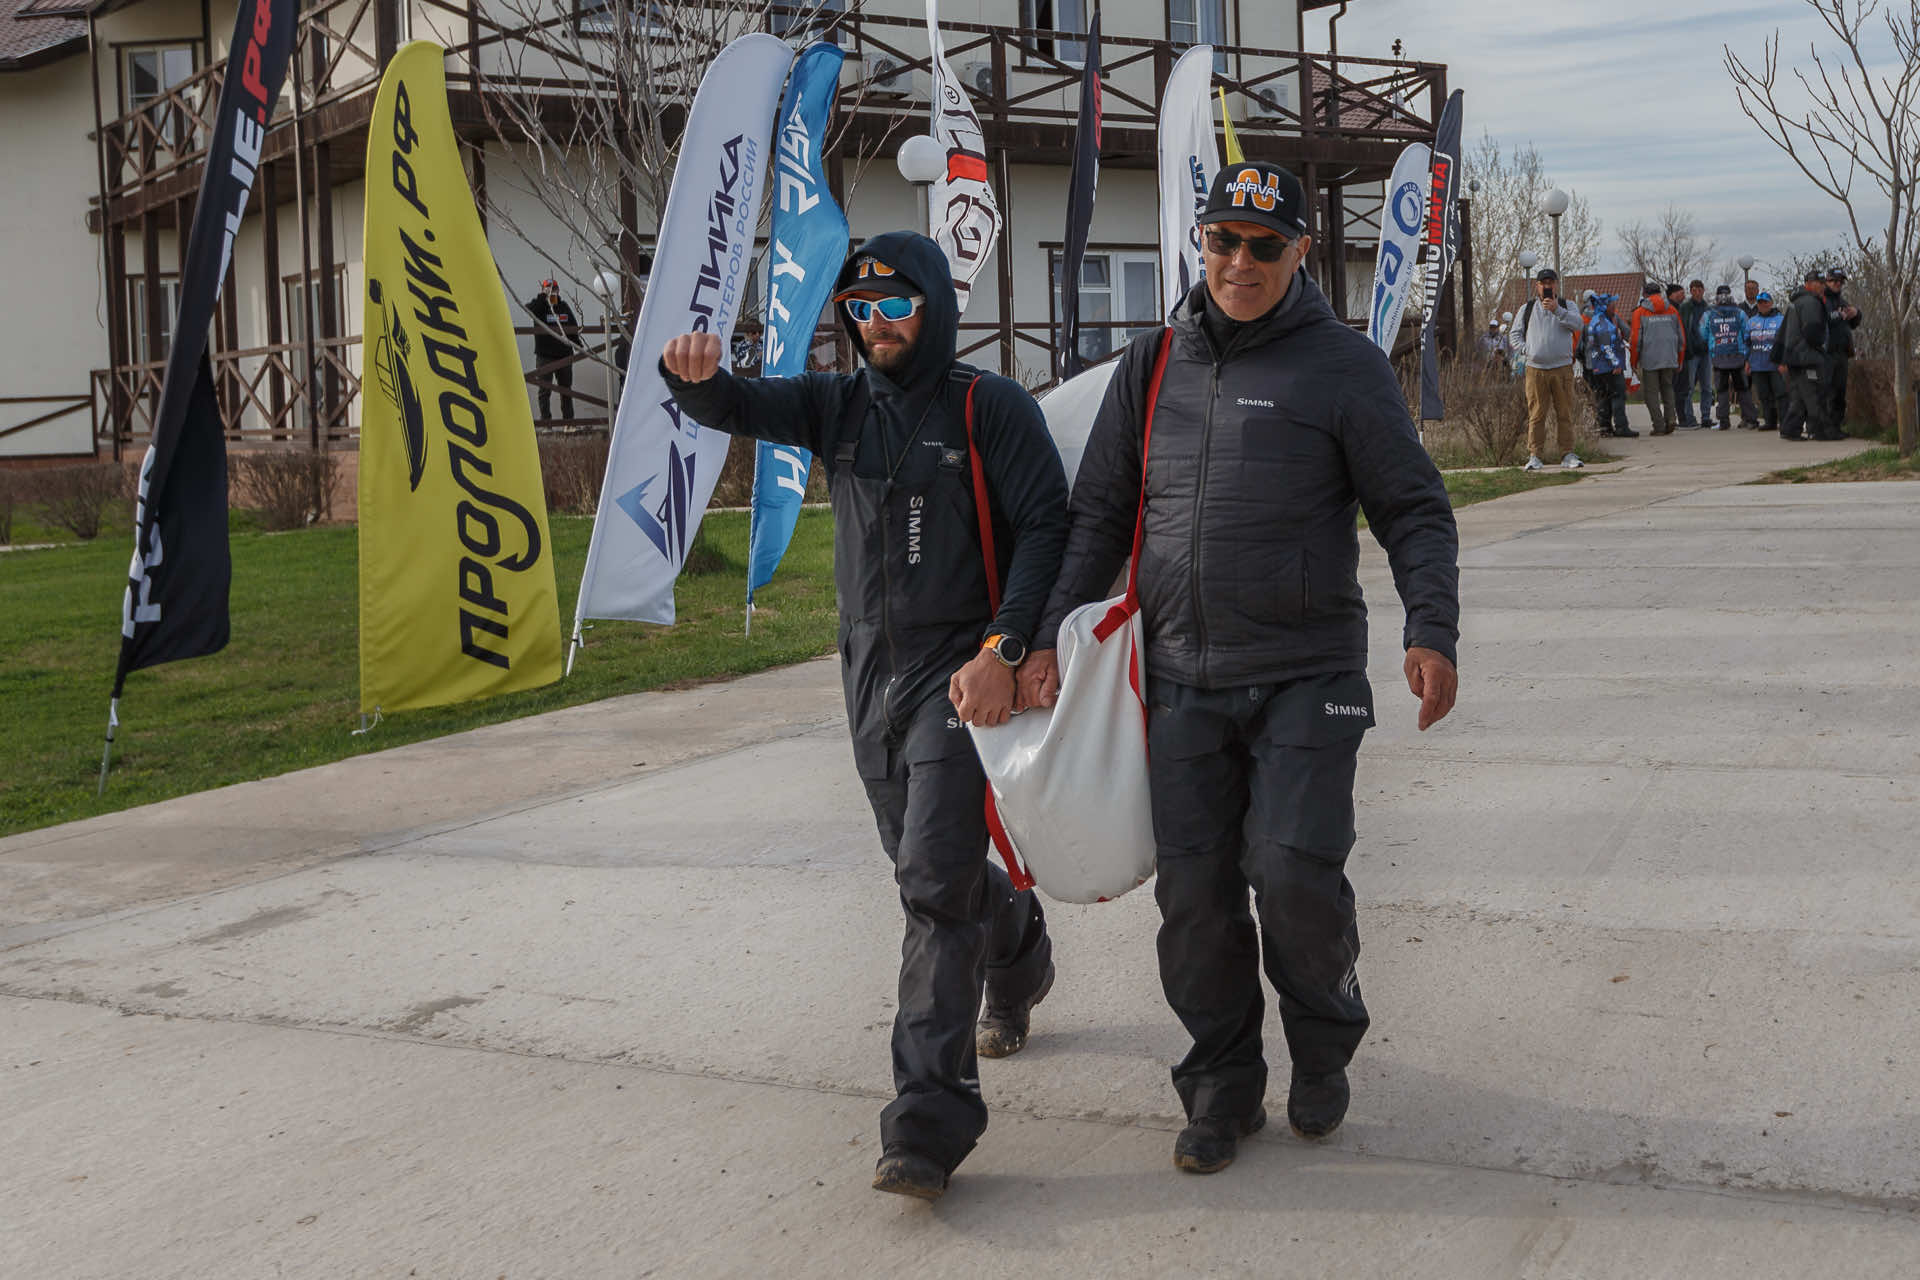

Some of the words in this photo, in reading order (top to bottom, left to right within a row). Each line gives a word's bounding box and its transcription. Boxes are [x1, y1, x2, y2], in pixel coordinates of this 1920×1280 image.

[1225, 182, 1285, 203] NARVAL
[716, 242, 743, 337] АТЕРОВ
[735, 136, 758, 238] РОССИИ
[1235, 397, 1275, 408] SIMMS
[908, 495, 924, 566] SIMMS
[1324, 702, 1369, 717] SIMMS
